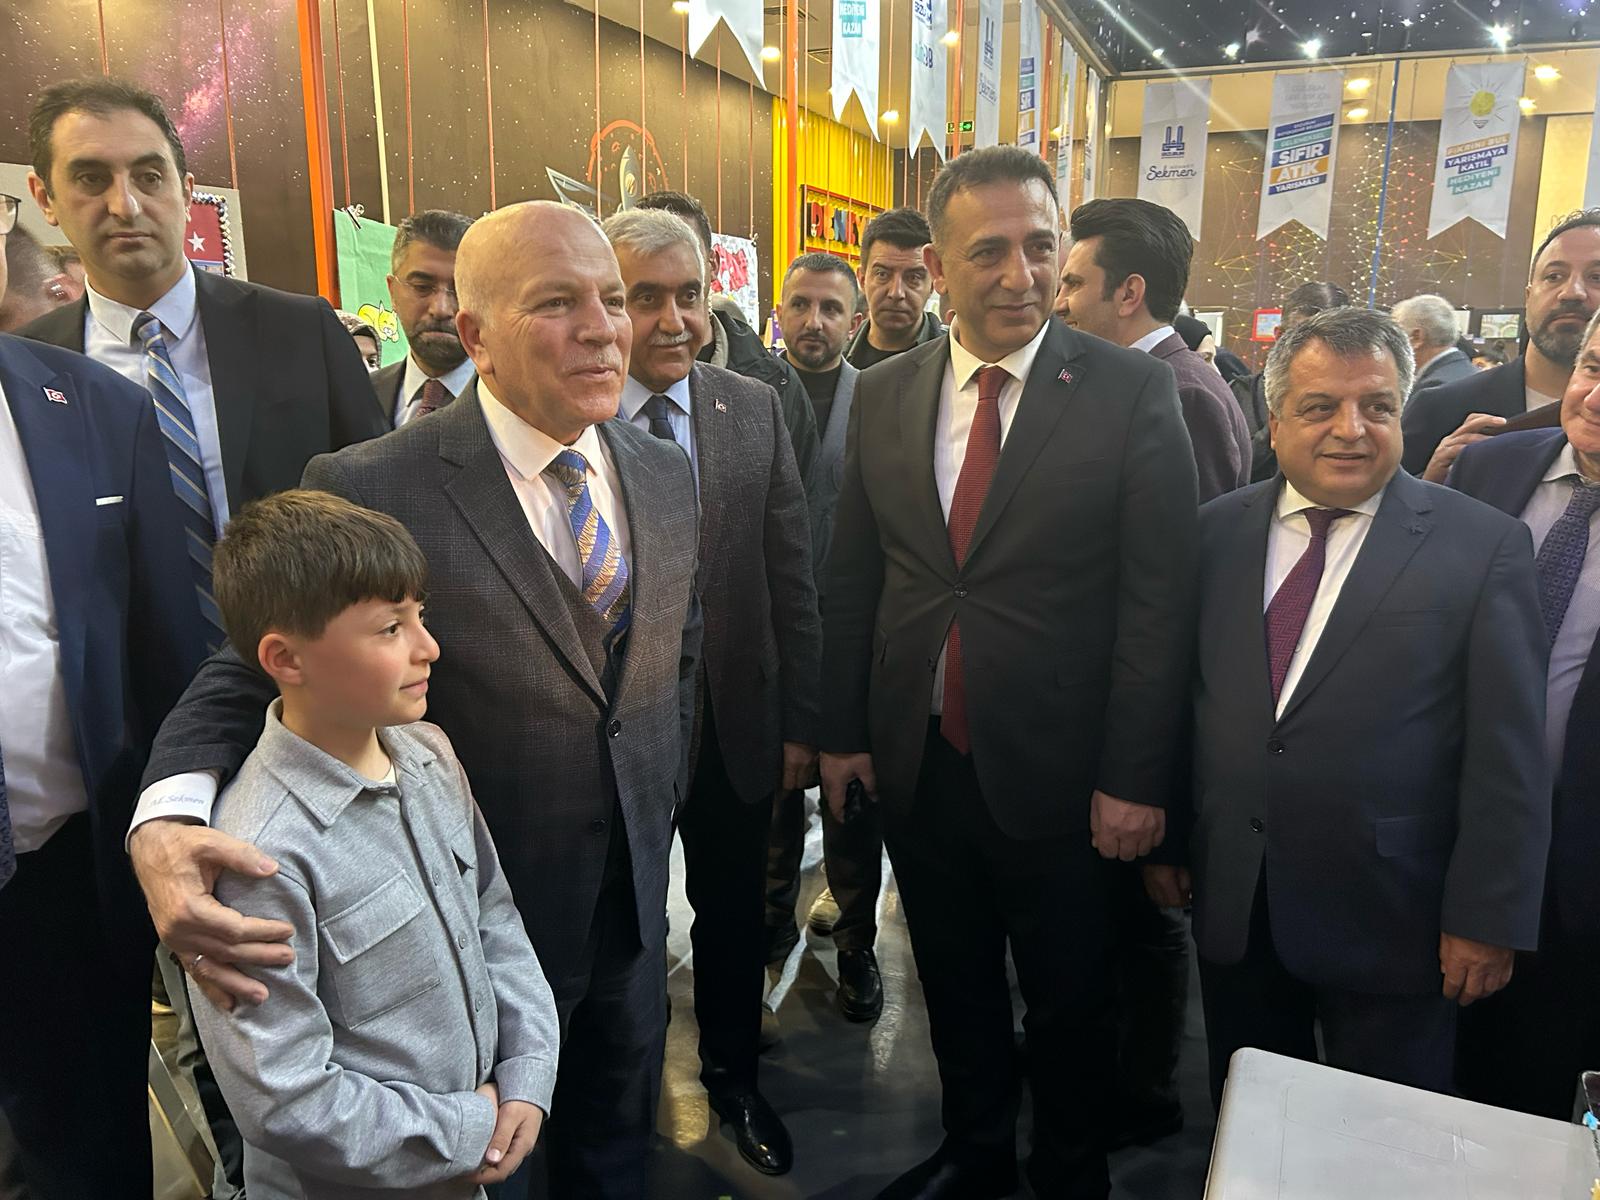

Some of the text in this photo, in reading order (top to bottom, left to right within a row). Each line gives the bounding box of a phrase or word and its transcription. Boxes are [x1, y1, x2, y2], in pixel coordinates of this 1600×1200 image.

[1278, 143, 1325, 165] SIFIR
[1146, 165, 1198, 181] Sekmen
[1276, 160, 1320, 182] ATIK
[1460, 160, 1490, 172] KATIL
